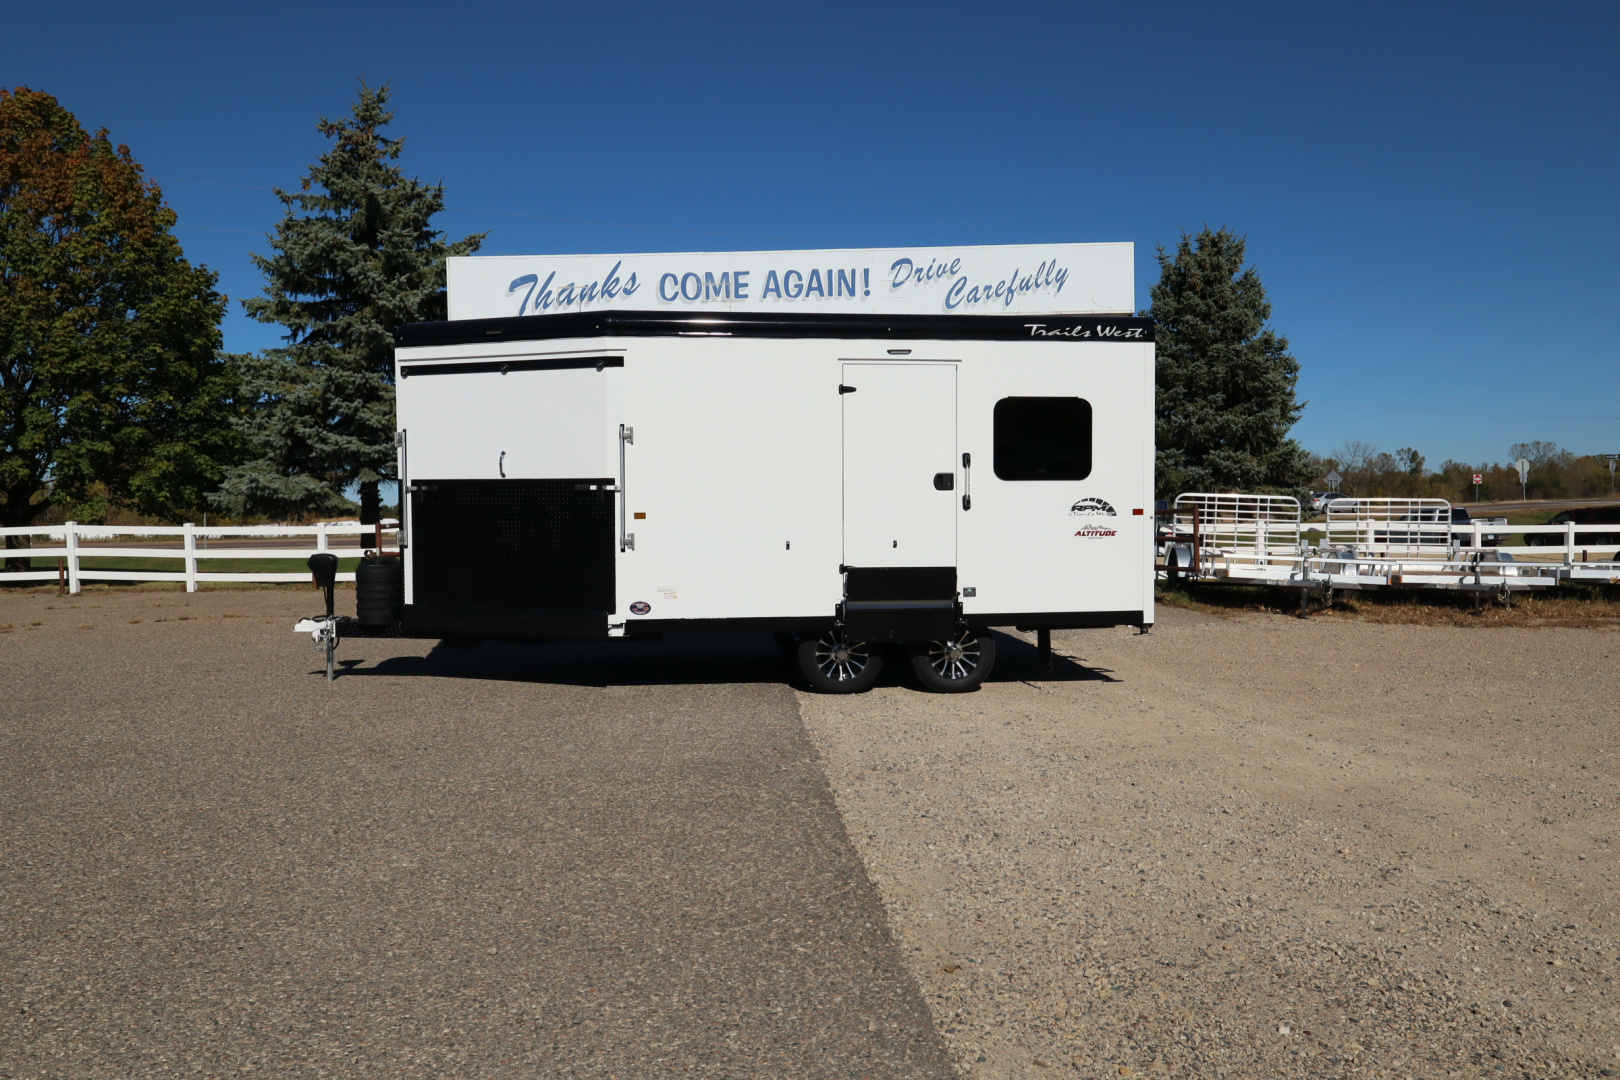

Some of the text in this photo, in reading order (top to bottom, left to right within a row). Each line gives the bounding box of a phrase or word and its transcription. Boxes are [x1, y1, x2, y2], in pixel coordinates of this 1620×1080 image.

[508, 259, 871, 317] Thanks COME AGAIN!
[890, 257, 962, 288] Drive
[945, 258, 1070, 310] Carefully
[1023, 323, 1144, 339] Trails West
